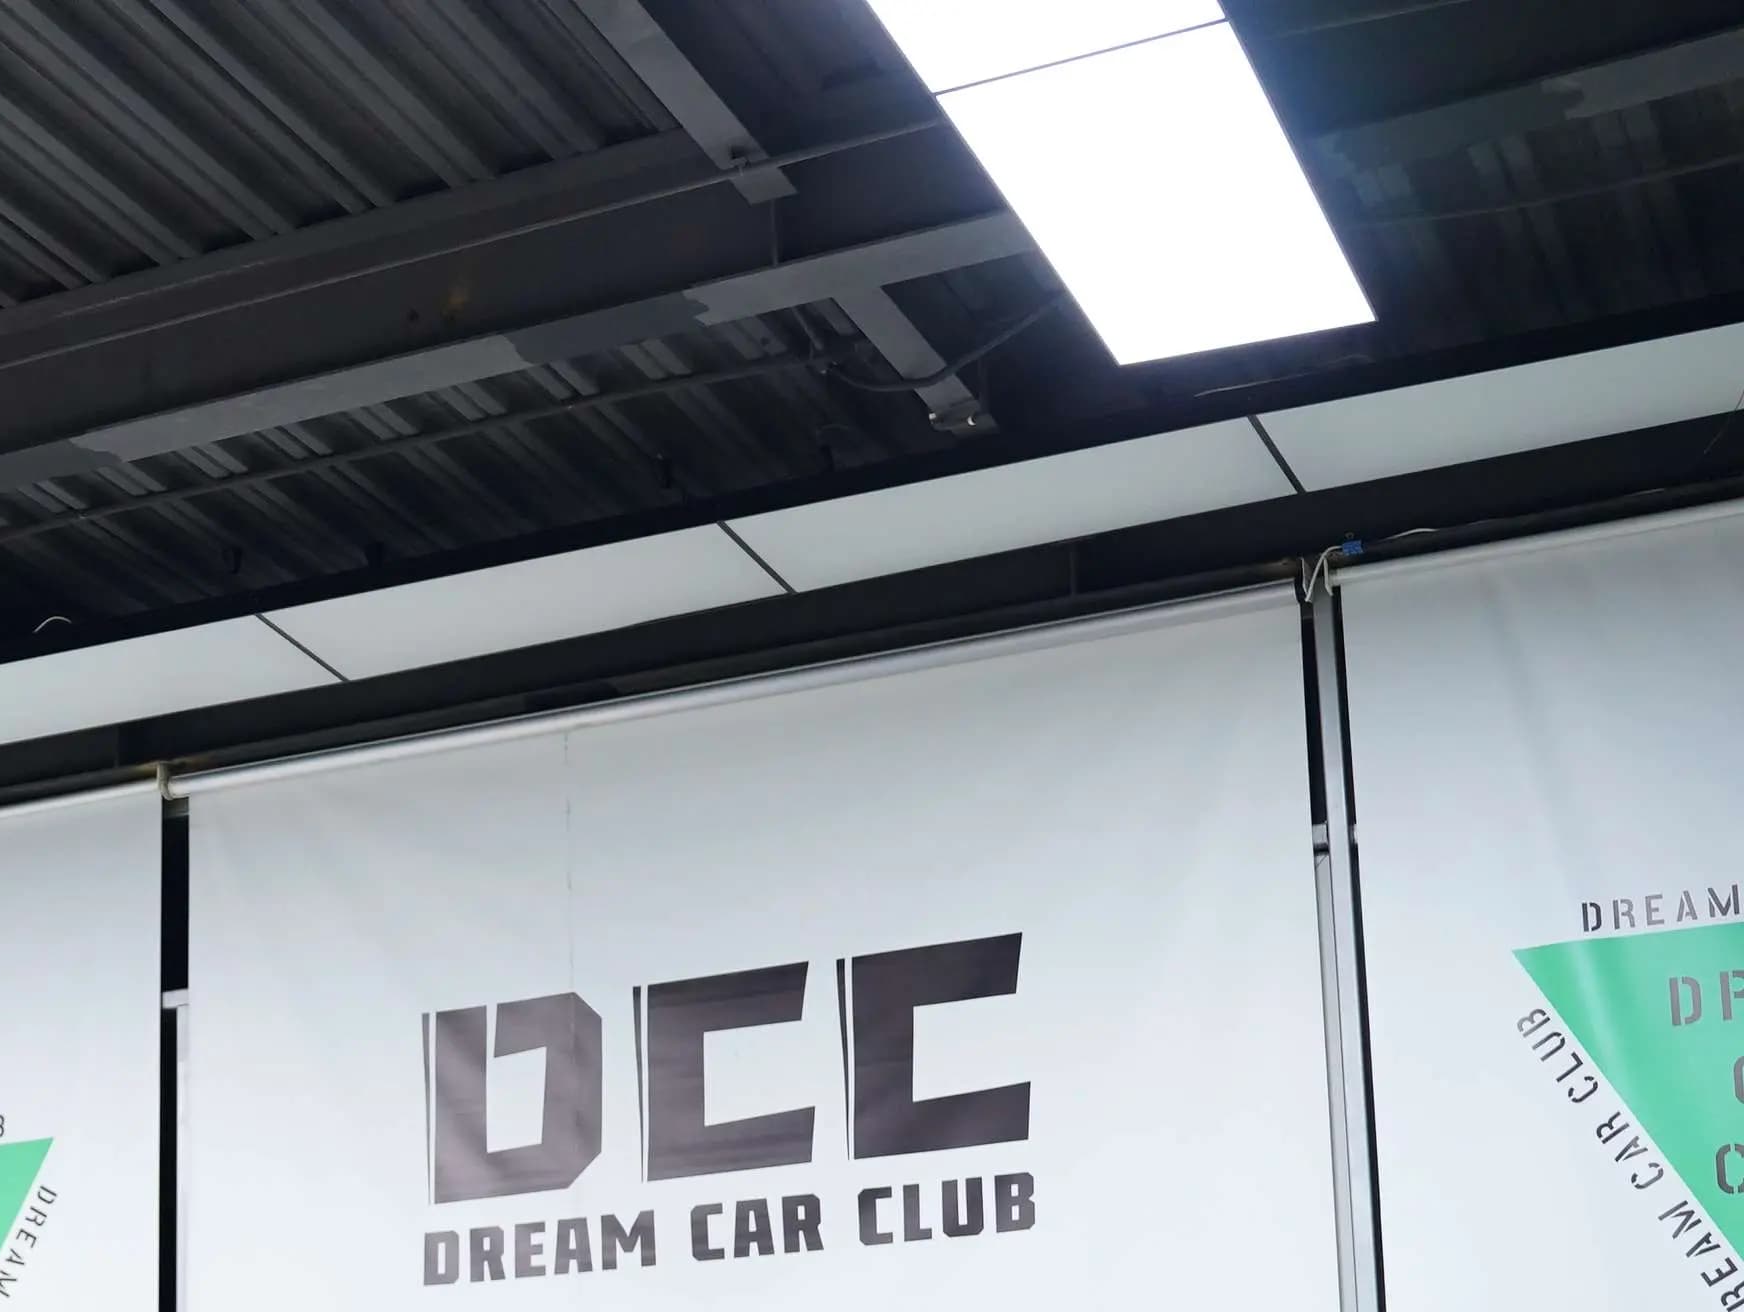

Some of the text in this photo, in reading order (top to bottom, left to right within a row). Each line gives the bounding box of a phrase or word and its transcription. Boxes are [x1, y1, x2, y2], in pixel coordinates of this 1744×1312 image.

[1581, 884, 1740, 933] DREAM
[421, 932, 1031, 1206] DCC
[1516, 1007, 1599, 1104] CLUB
[1596, 1110, 1664, 1191] CAR
[422, 1171, 1035, 1287] DREAM CAR CLUB
